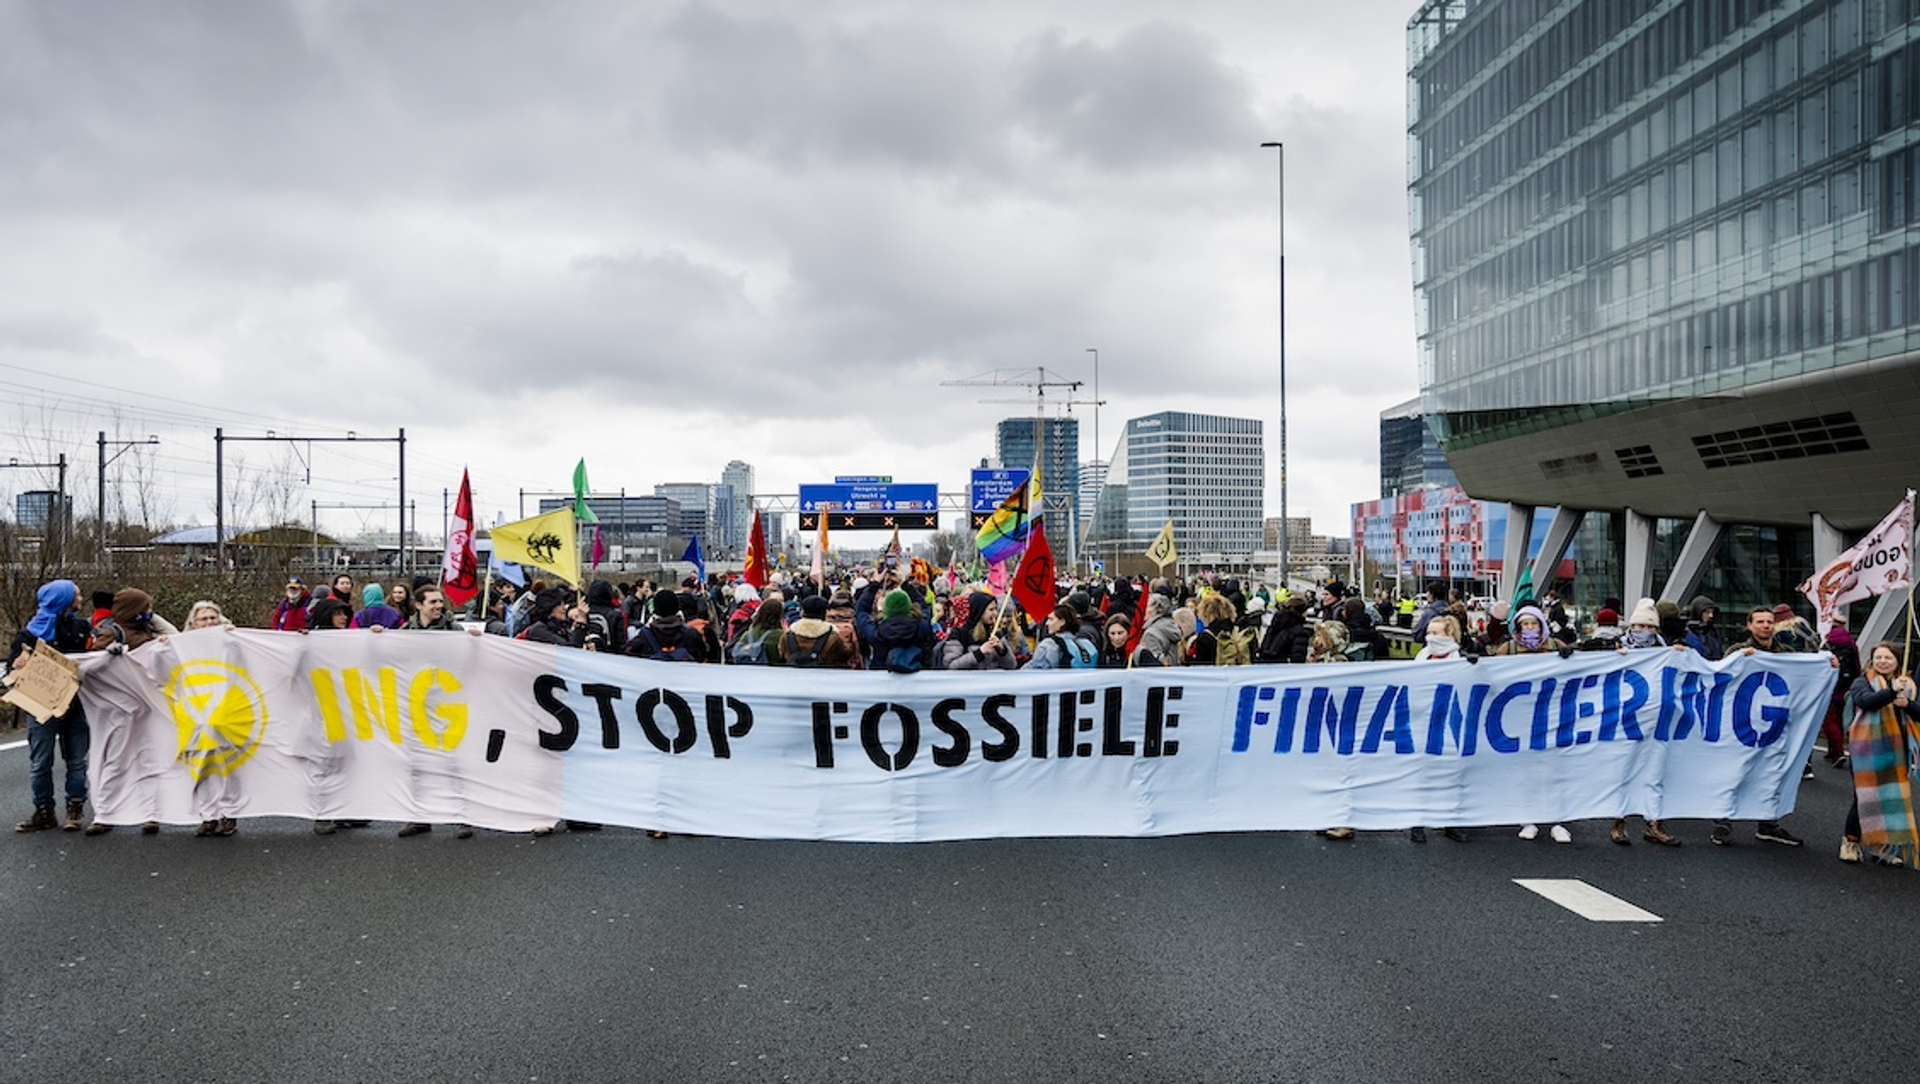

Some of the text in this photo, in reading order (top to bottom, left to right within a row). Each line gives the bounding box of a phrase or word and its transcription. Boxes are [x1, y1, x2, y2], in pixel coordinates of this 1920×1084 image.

[533, 674, 754, 760] STOP
[811, 686, 1184, 772] FOSSIELE
[1231, 666, 1791, 758] FINANCIERING
